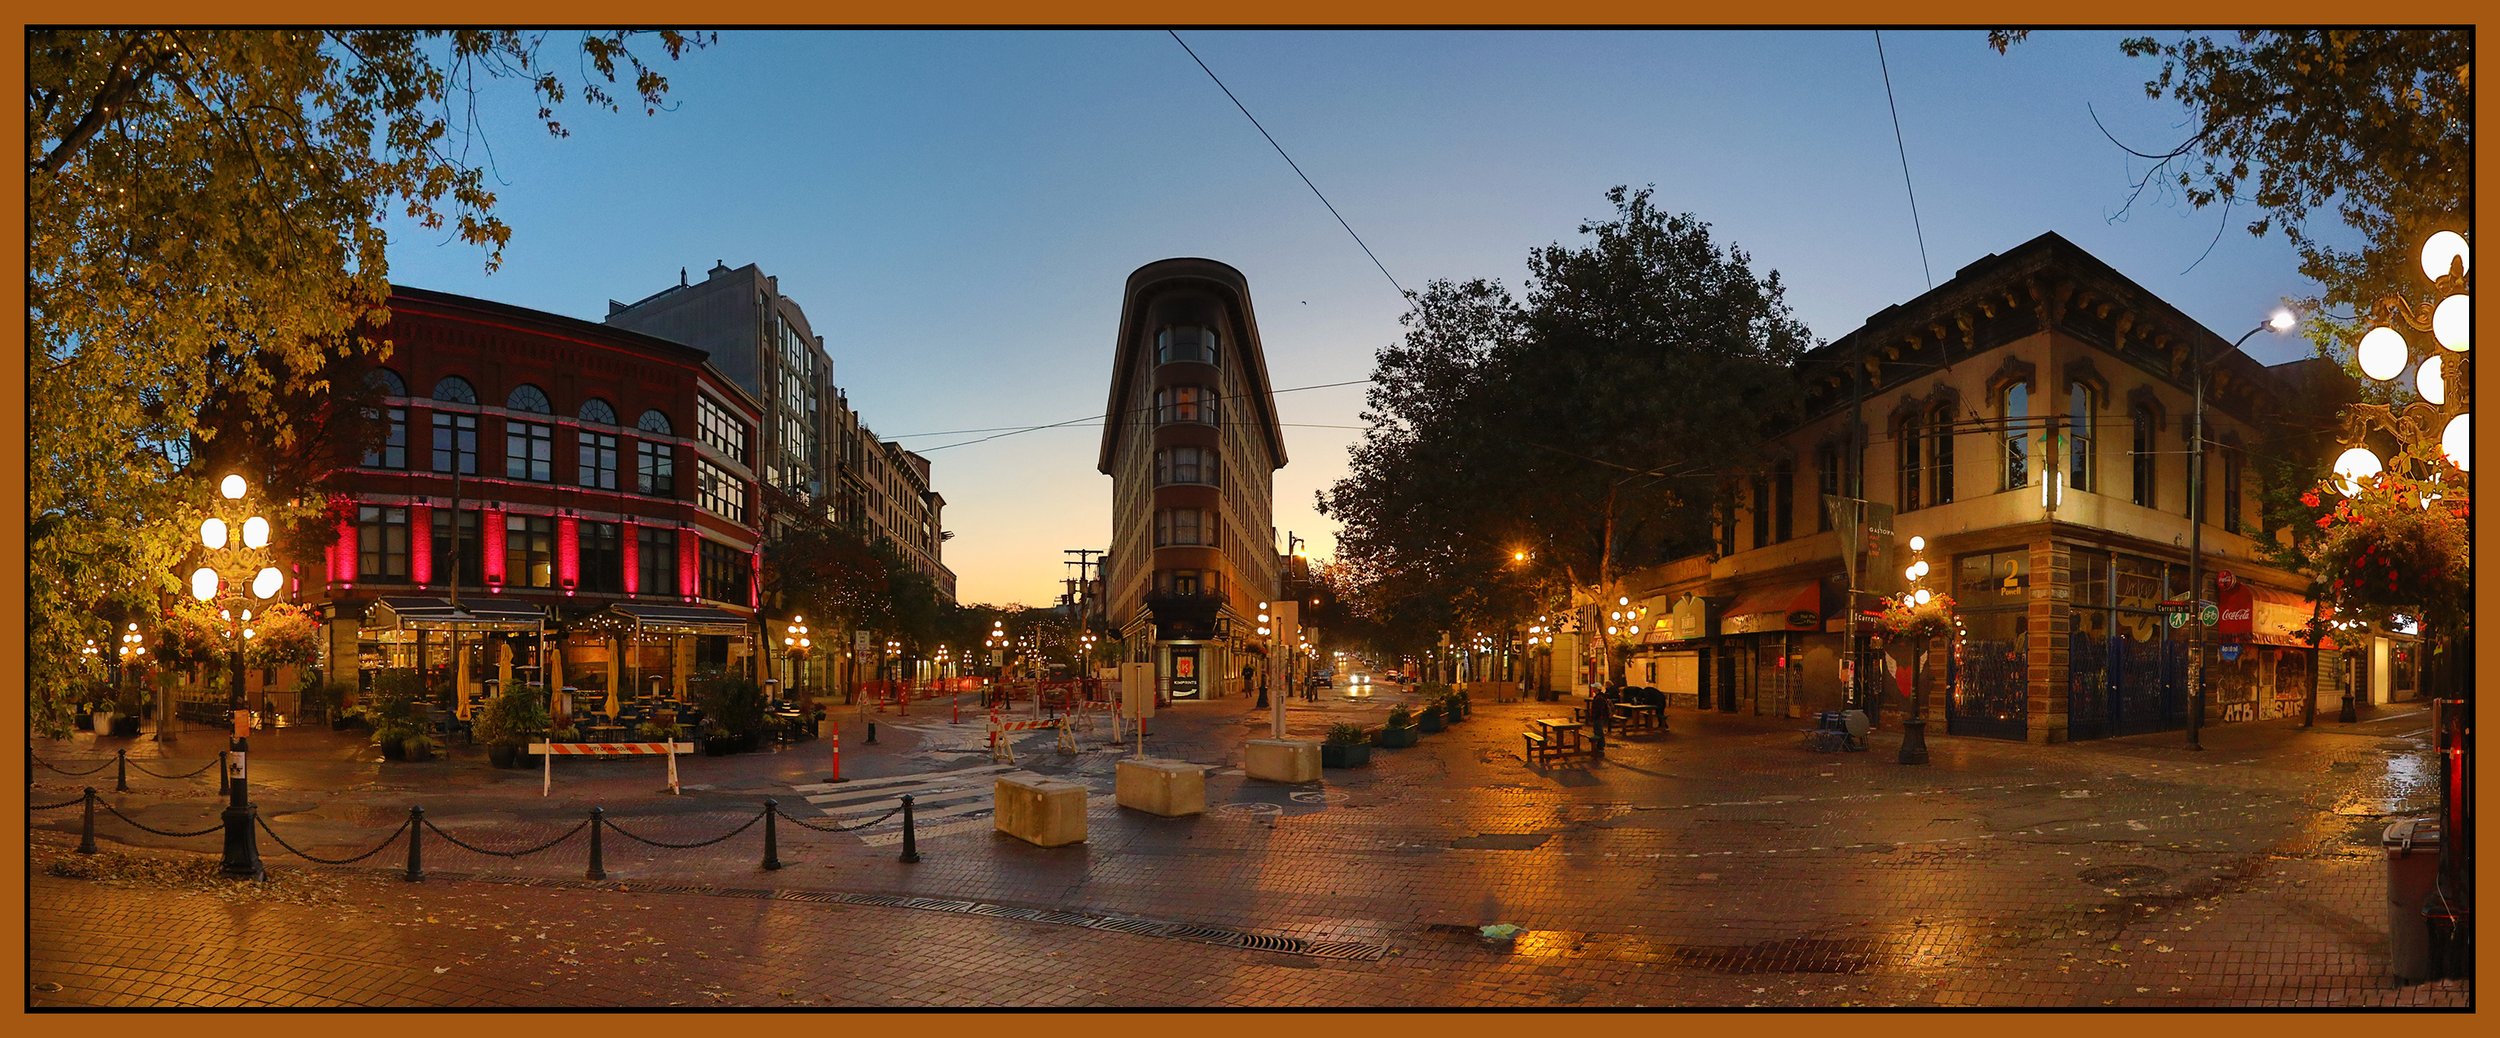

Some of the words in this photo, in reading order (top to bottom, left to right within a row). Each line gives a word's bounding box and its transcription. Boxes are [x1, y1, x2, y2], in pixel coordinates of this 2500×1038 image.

[1868, 527, 1894, 536] GASTOWN
[2004, 560, 2018, 587] 2
[2000, 587, 2022, 596] Powell
